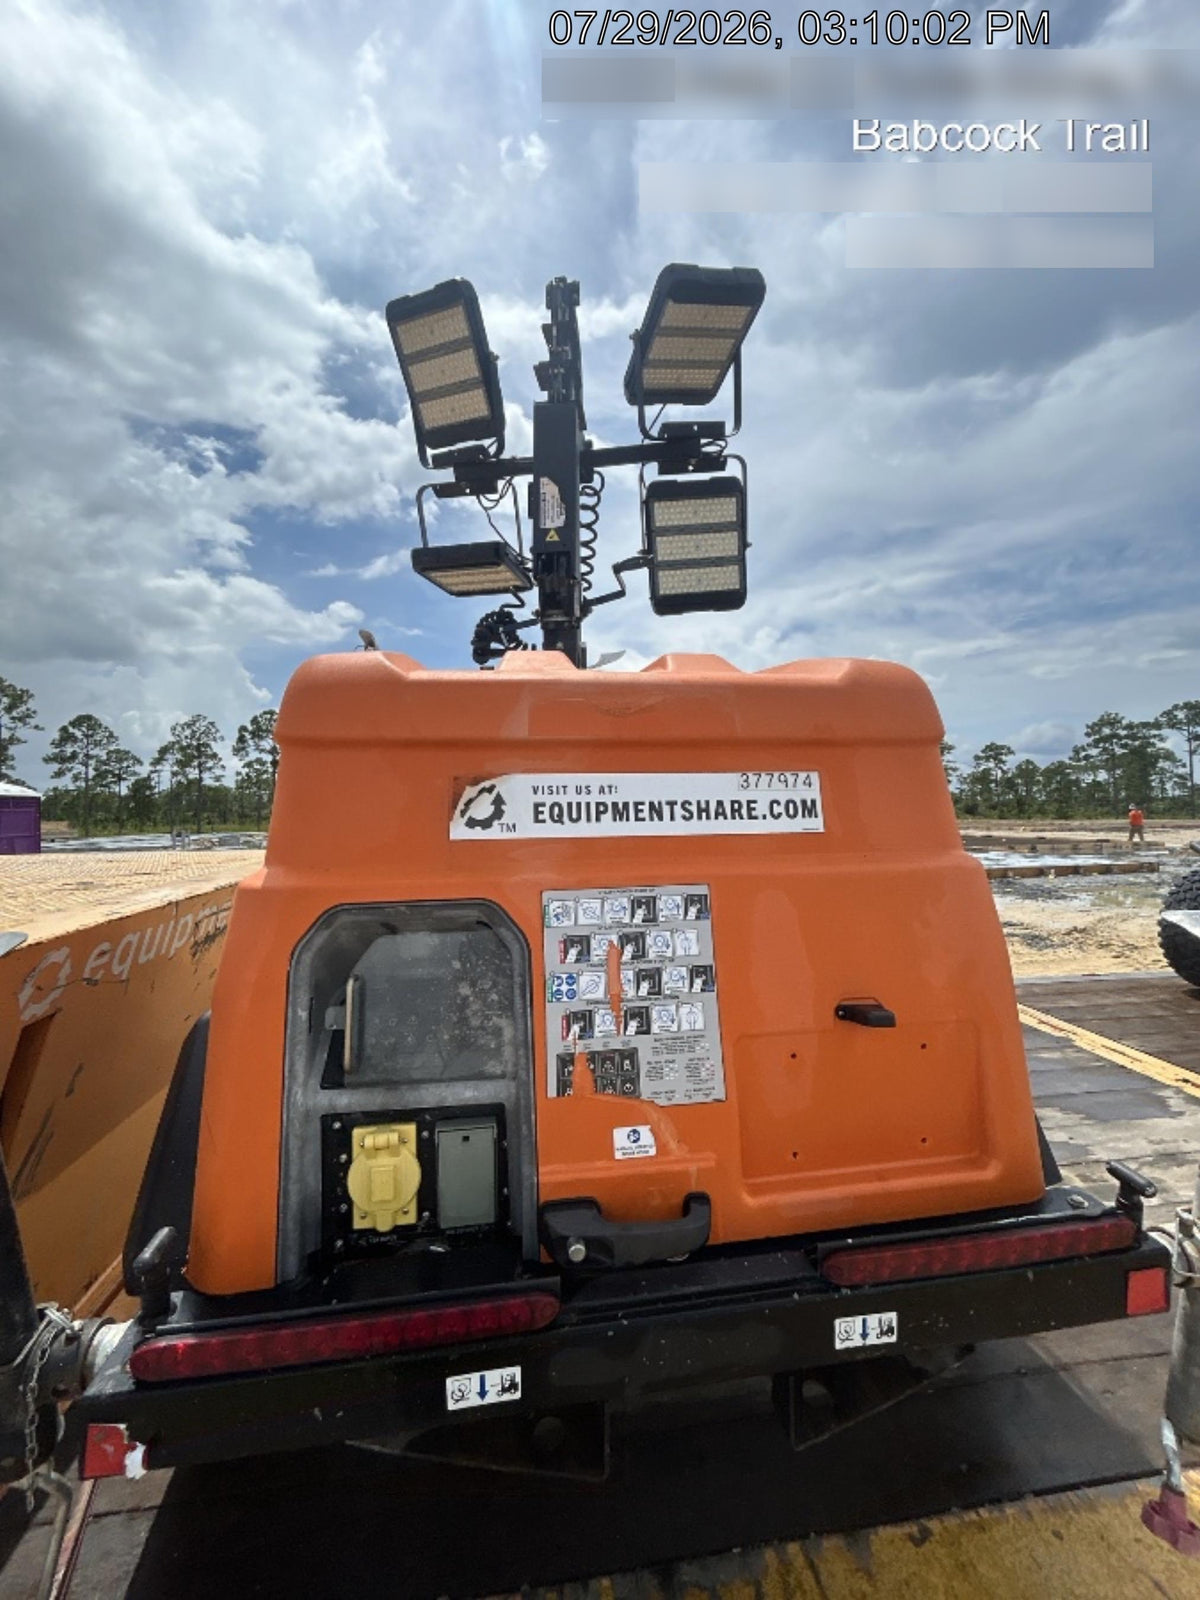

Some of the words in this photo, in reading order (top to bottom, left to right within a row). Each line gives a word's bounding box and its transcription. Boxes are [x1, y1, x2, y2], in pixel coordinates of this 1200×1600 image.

[740, 773, 814, 790] 377974
[532, 785, 569, 796] VISIT
[575, 785, 593, 795] US
[598, 784, 619, 795] AT:
[533, 800, 819, 825] EQUIPMENTSHARE.COM
[498, 822, 517, 834] TM
